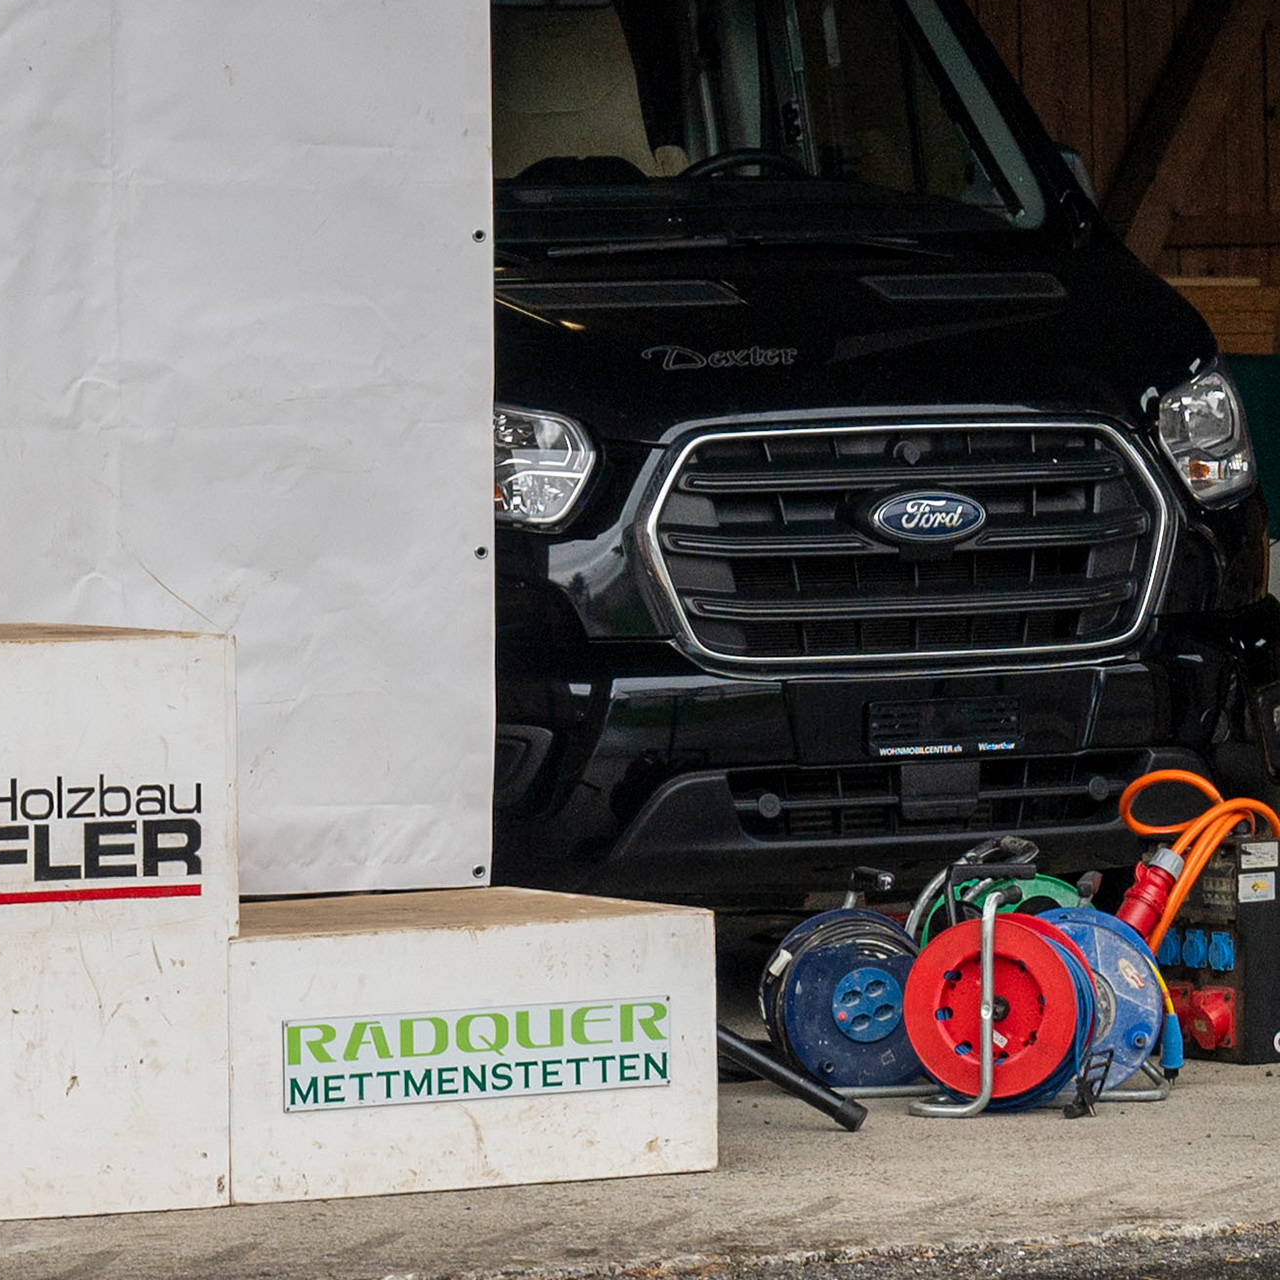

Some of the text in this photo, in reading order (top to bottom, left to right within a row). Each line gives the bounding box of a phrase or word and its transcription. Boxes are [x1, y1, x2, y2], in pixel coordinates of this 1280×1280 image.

[642, 345, 798, 370] Dexter
[901, 499, 963, 529] Ford
[287, 1001, 668, 1066] RADQUER
[289, 1051, 668, 1106] METTMENSTETTEN
